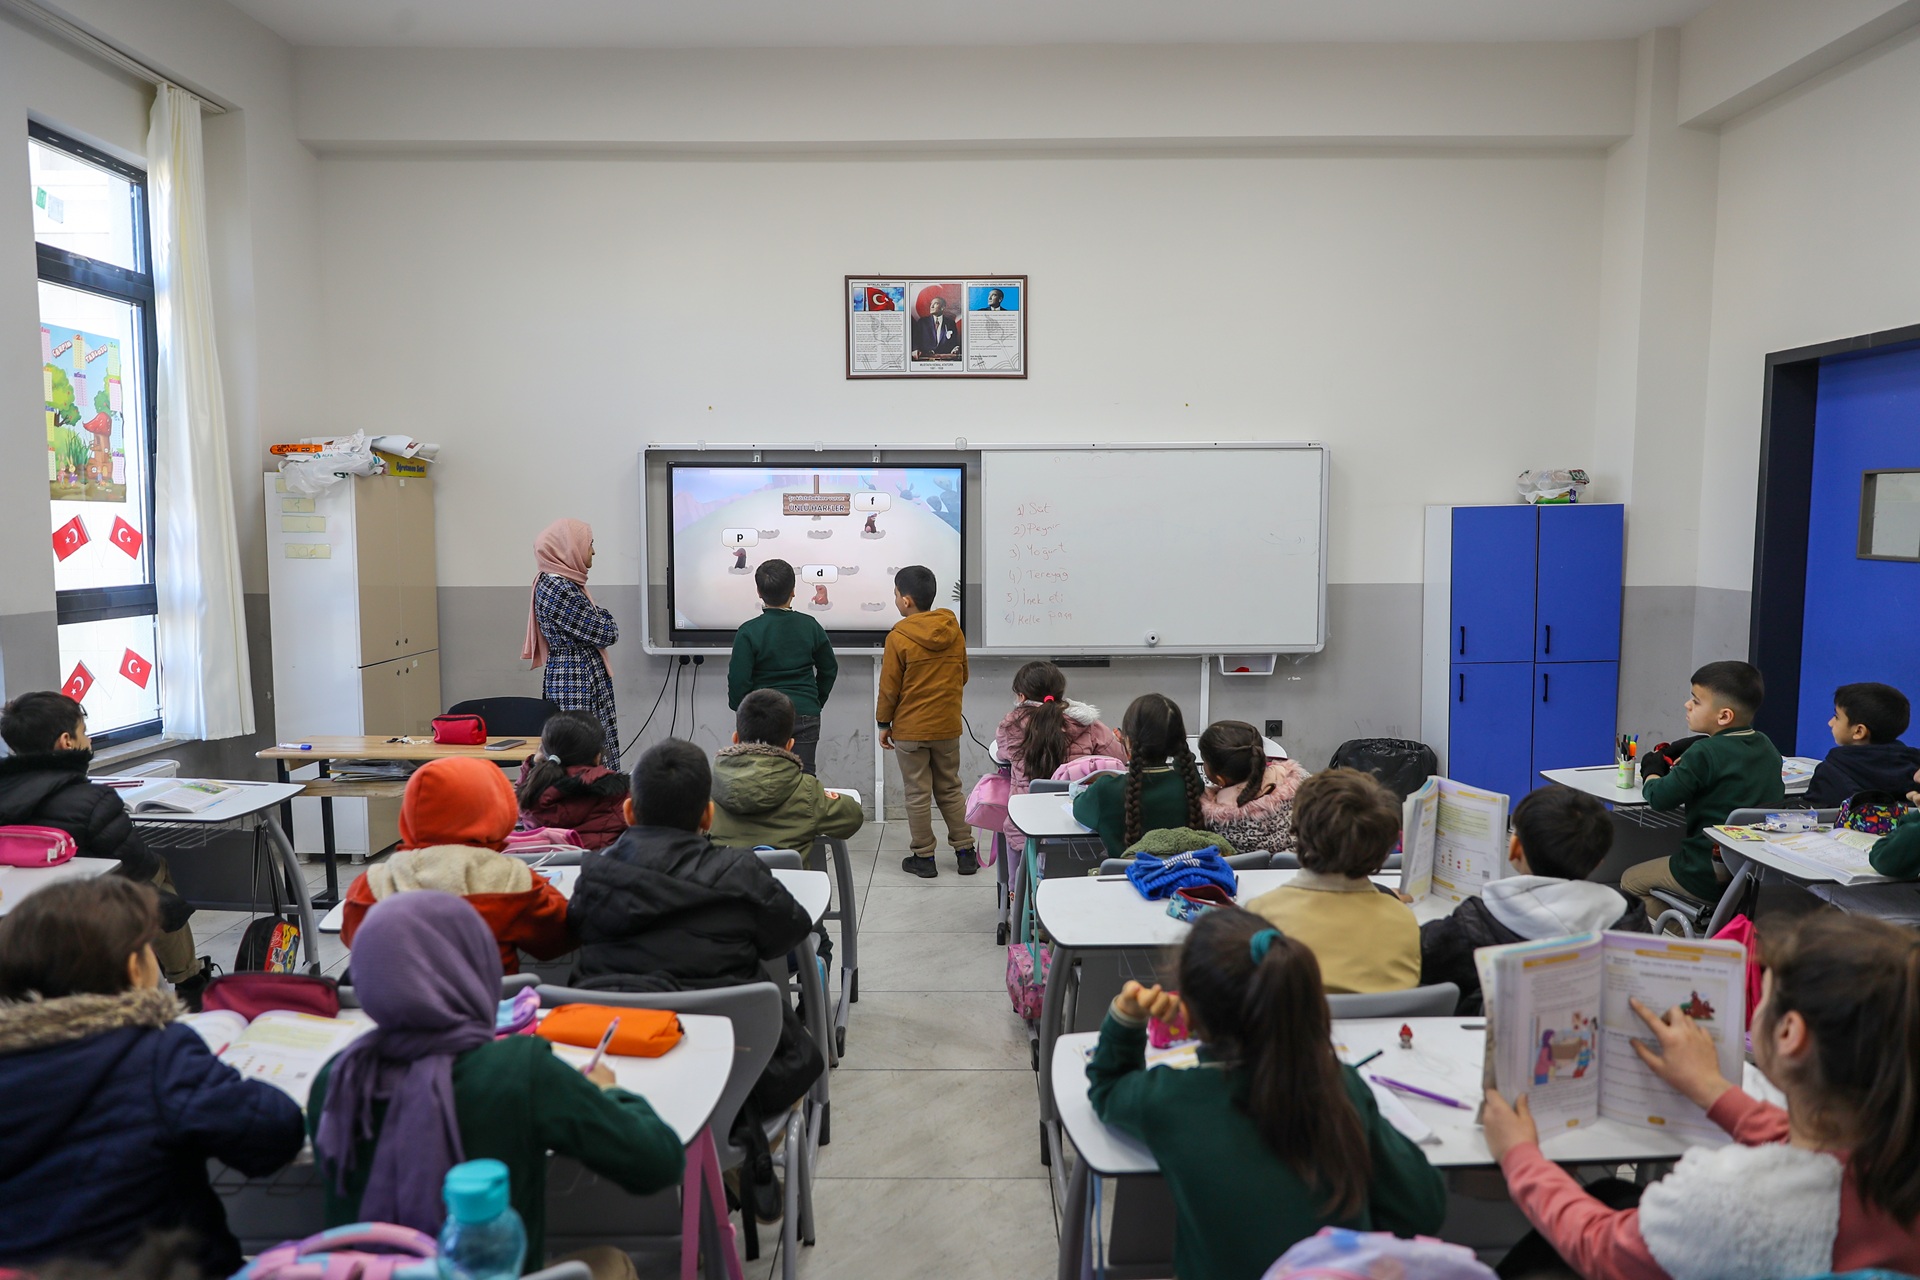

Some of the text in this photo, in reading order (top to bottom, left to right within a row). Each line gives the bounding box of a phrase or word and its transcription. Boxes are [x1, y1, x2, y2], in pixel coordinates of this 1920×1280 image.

[870, 496, 875, 506] f
[1013, 522, 1060, 538] 2) Peynir
[736, 533, 743, 542] p
[1009, 543, 1021, 561] 3)
[816, 568, 823, 577] d
